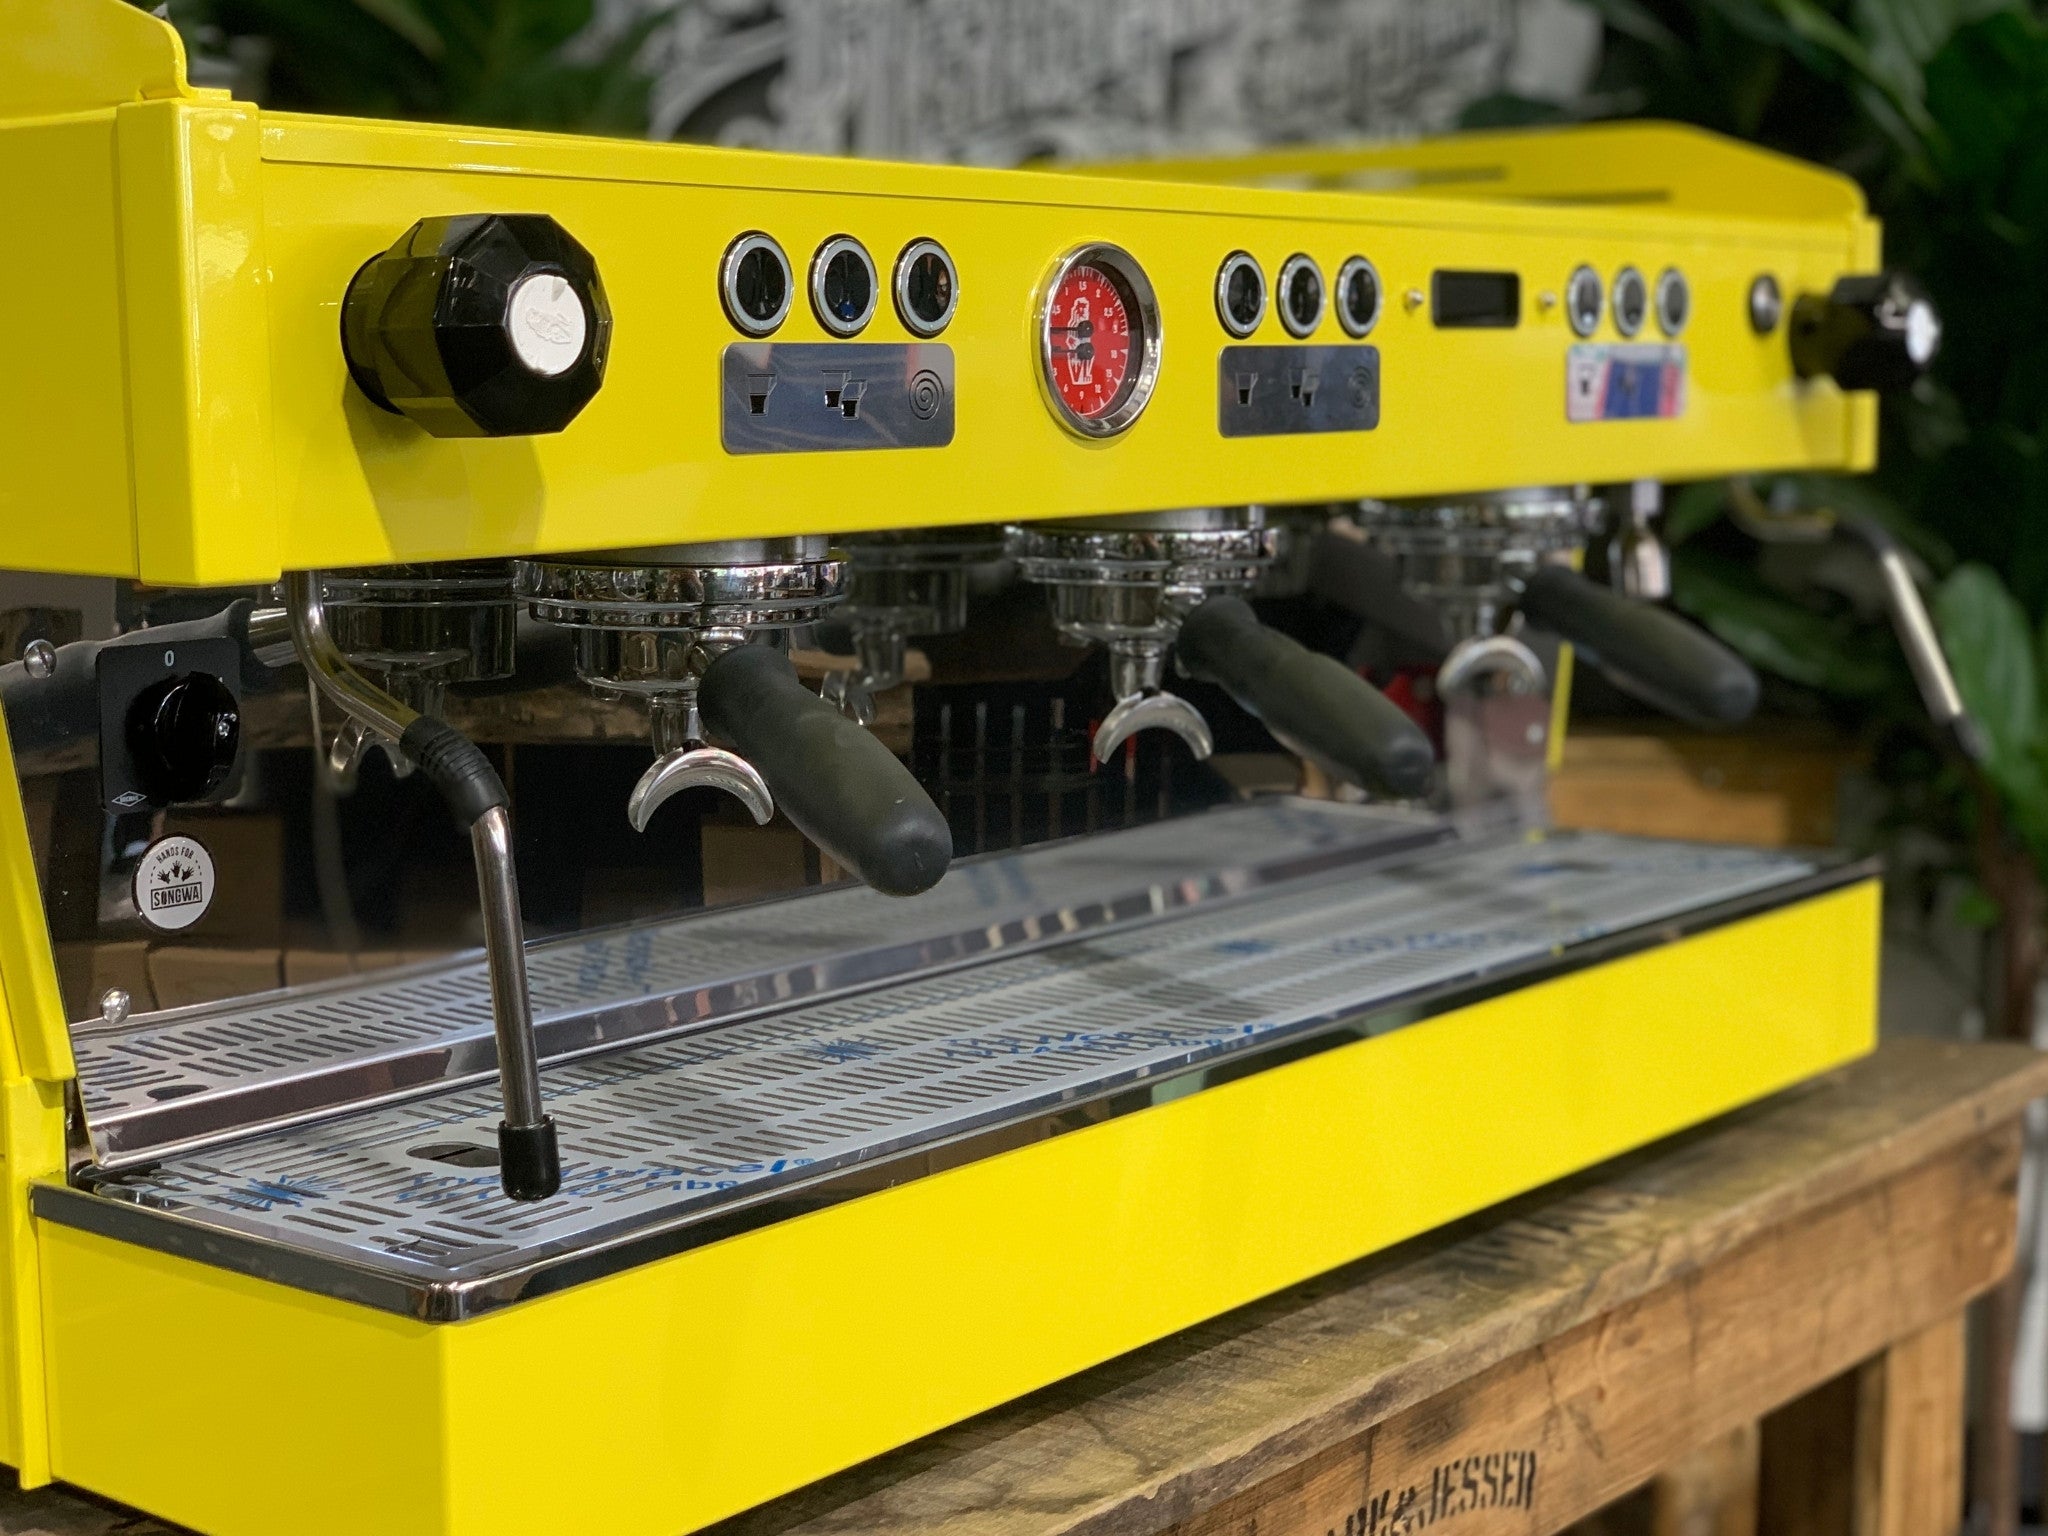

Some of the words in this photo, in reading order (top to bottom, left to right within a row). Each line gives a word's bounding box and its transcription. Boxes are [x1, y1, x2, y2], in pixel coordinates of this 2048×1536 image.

[1079, 390, 1085, 400] 9
[156, 846, 179, 864] HANDS
[180, 846, 194, 860] FOR
[153, 885, 200, 907] SONGWA
